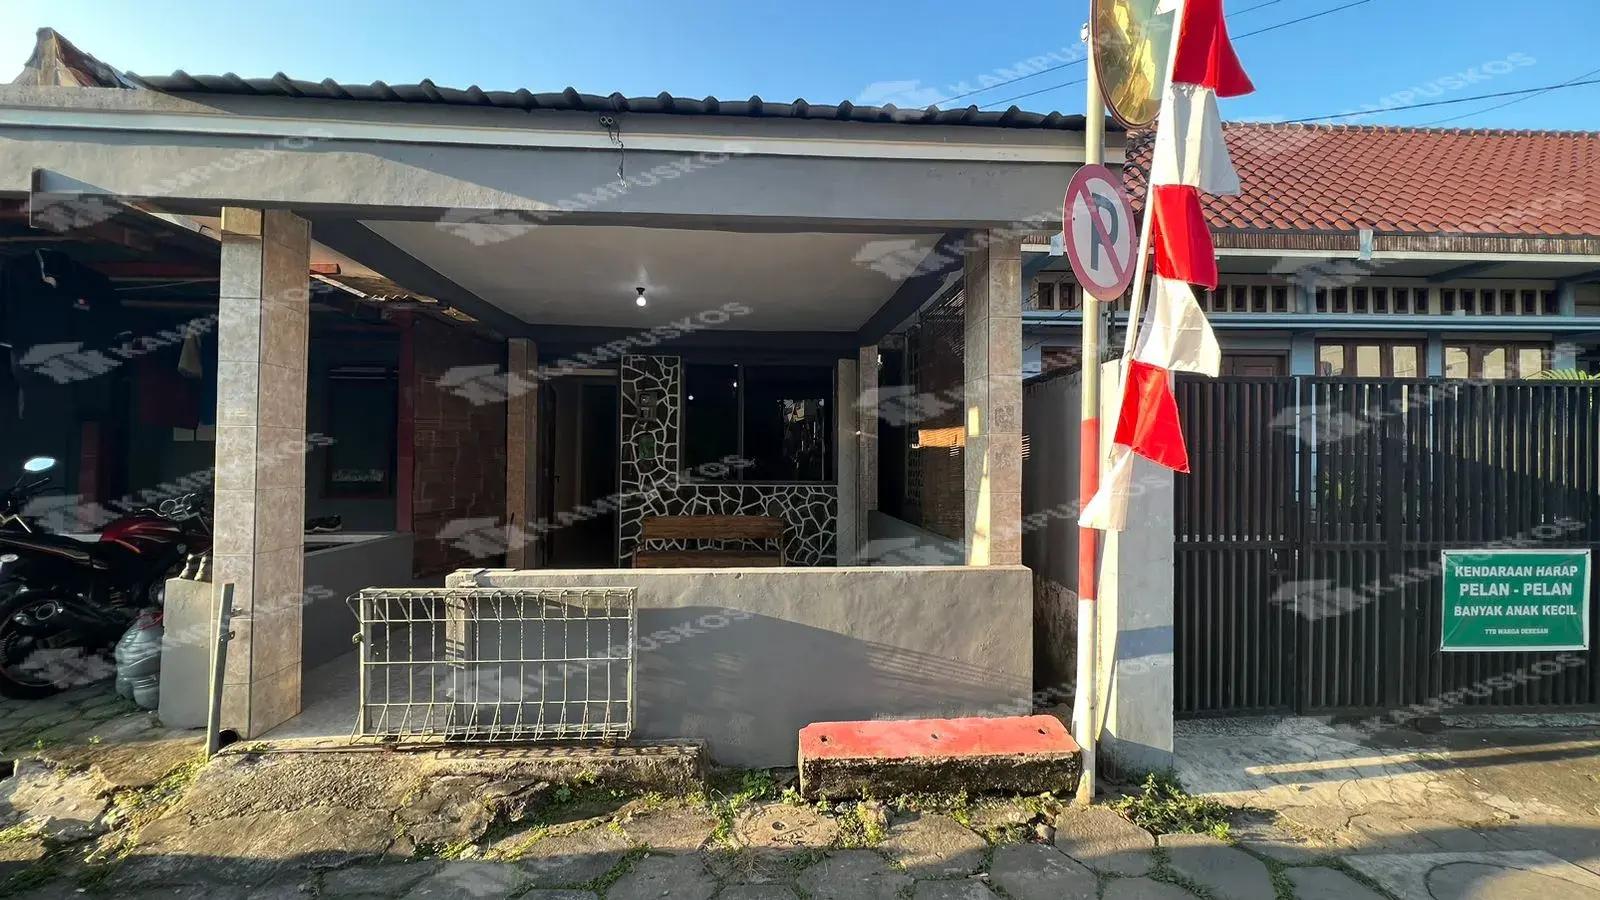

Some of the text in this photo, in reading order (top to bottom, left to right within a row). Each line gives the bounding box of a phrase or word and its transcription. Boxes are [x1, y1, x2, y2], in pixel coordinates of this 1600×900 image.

[1090, 192, 1119, 271] P
[1455, 566, 1578, 577] KENDARAAN HARAP
[1460, 583, 1510, 596] PELAN
[1523, 582, 1572, 596] PELAN
[1454, 604, 1577, 617] BANYAK ANAK KECIL
